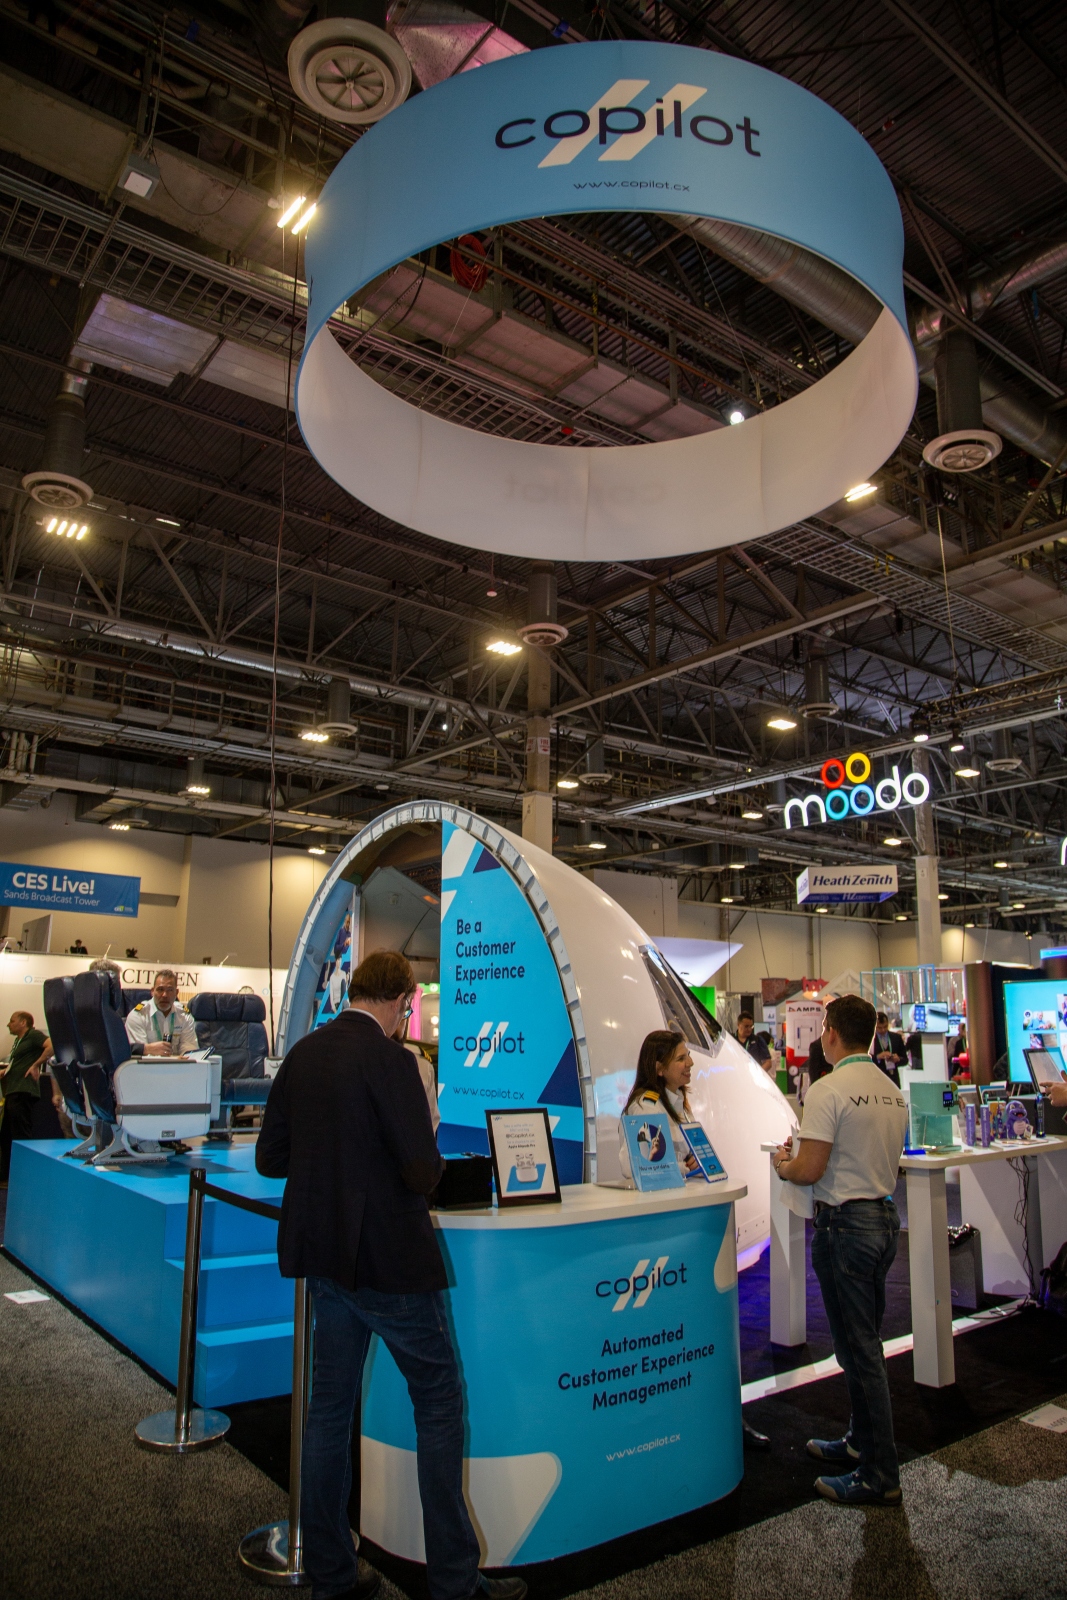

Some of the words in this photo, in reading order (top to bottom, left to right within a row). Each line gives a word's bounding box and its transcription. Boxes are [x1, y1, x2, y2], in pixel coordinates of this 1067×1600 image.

[495, 97, 761, 158] copilot
[573, 180, 690, 192] www.copilot.cx
[784, 765, 930, 829] moodo
[12, 871, 48, 890] CES
[52, 875, 95, 895] Live!
[4, 889, 29, 900] Sands
[31, 892, 72, 903] Broadcast
[74, 896, 100, 906] Tower
[456, 919, 472, 935] Be
[474, 920, 482, 934] a
[455, 940, 516, 958] Customer
[122, 968, 200, 987] CITEN
[455, 963, 525, 986] Experience
[454, 988, 477, 1005] Ace
[453, 1031, 525, 1057] copilot
[452, 1085, 525, 1101] www.copilot.cx
[849, 1094, 906, 1108] WIDE
[595, 1262, 687, 1298] copilot
[601, 1323, 684, 1357] Automated
[558, 1362, 638, 1390] Customer
[641, 1343, 715, 1375] Experience
[592, 1371, 692, 1411] Management
[605, 1434, 681, 1462] www.copilot.cx
